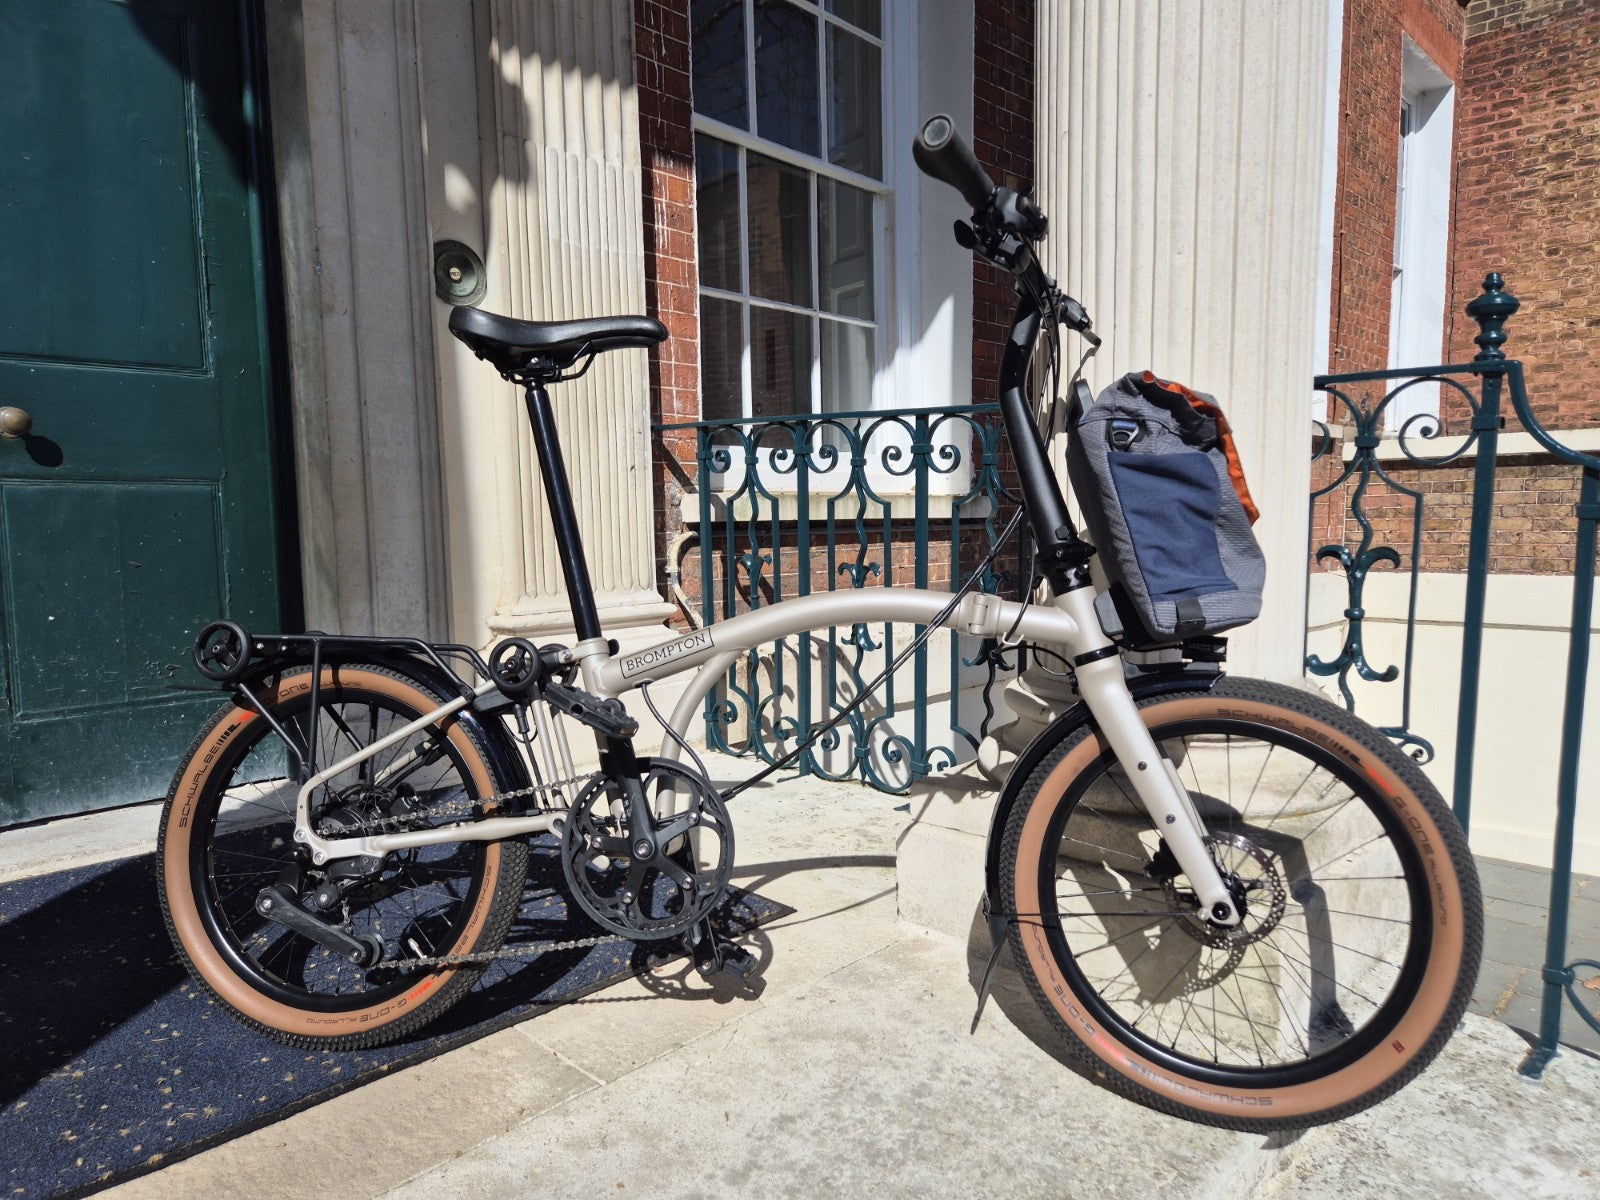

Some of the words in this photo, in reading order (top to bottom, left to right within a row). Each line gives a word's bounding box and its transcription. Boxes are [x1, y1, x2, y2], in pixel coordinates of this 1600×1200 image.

[625, 633, 707, 671] BROMPTON
[1216, 708, 1325, 743] SCHWALBE
[178, 745, 218, 829] SCHWALBE
[1391, 796, 1435, 855] G-ONE
[359, 998, 408, 1023] G-ONE
[1053, 984, 1096, 1036] G-ONE
